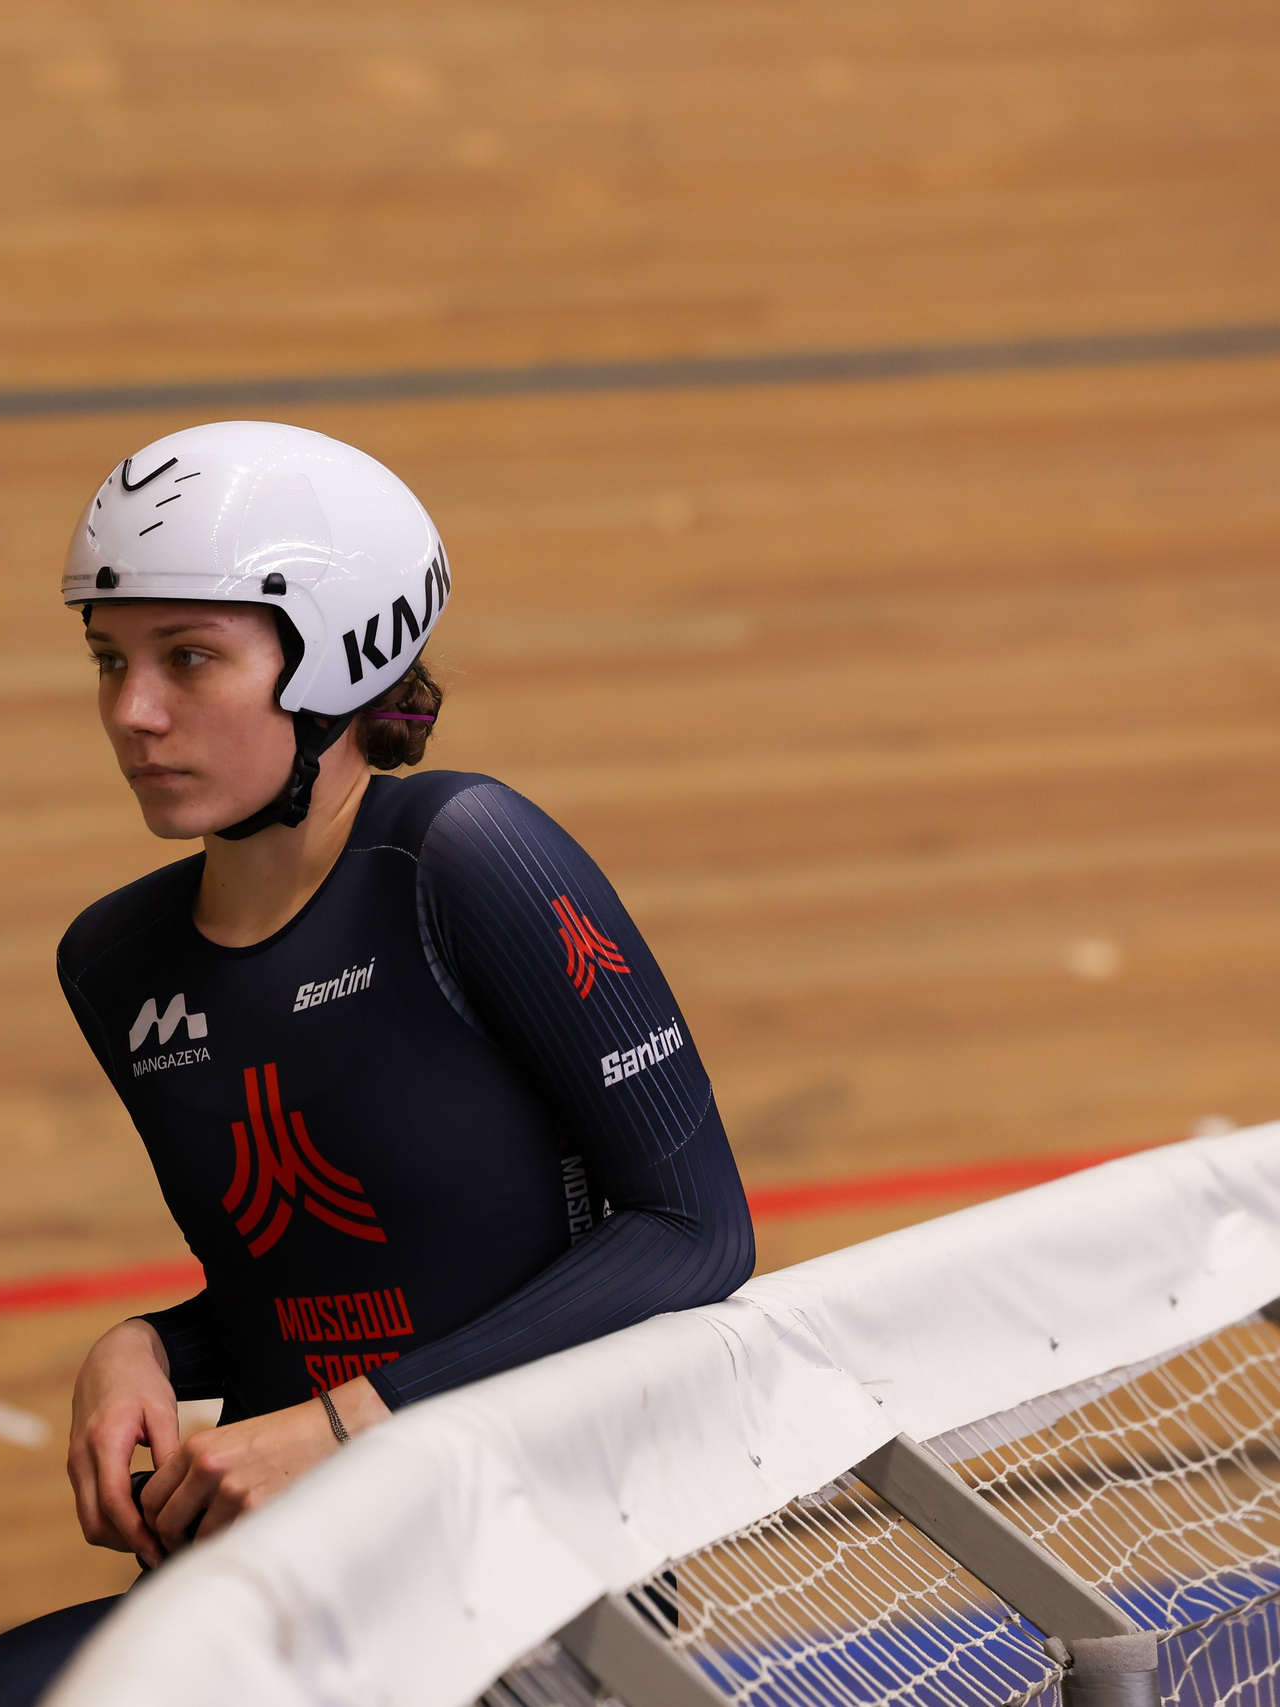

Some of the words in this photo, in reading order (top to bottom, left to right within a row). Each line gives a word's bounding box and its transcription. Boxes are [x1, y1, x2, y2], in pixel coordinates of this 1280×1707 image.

[342, 541, 451, 685] KASK
[292, 957, 376, 1013] Santini
[132, 1047, 211, 1078] MANGAZEYA
[600, 1016, 684, 1088] Santini
[561, 1154, 594, 1247] MOSC
[274, 1287, 415, 1342] MOSCOW
